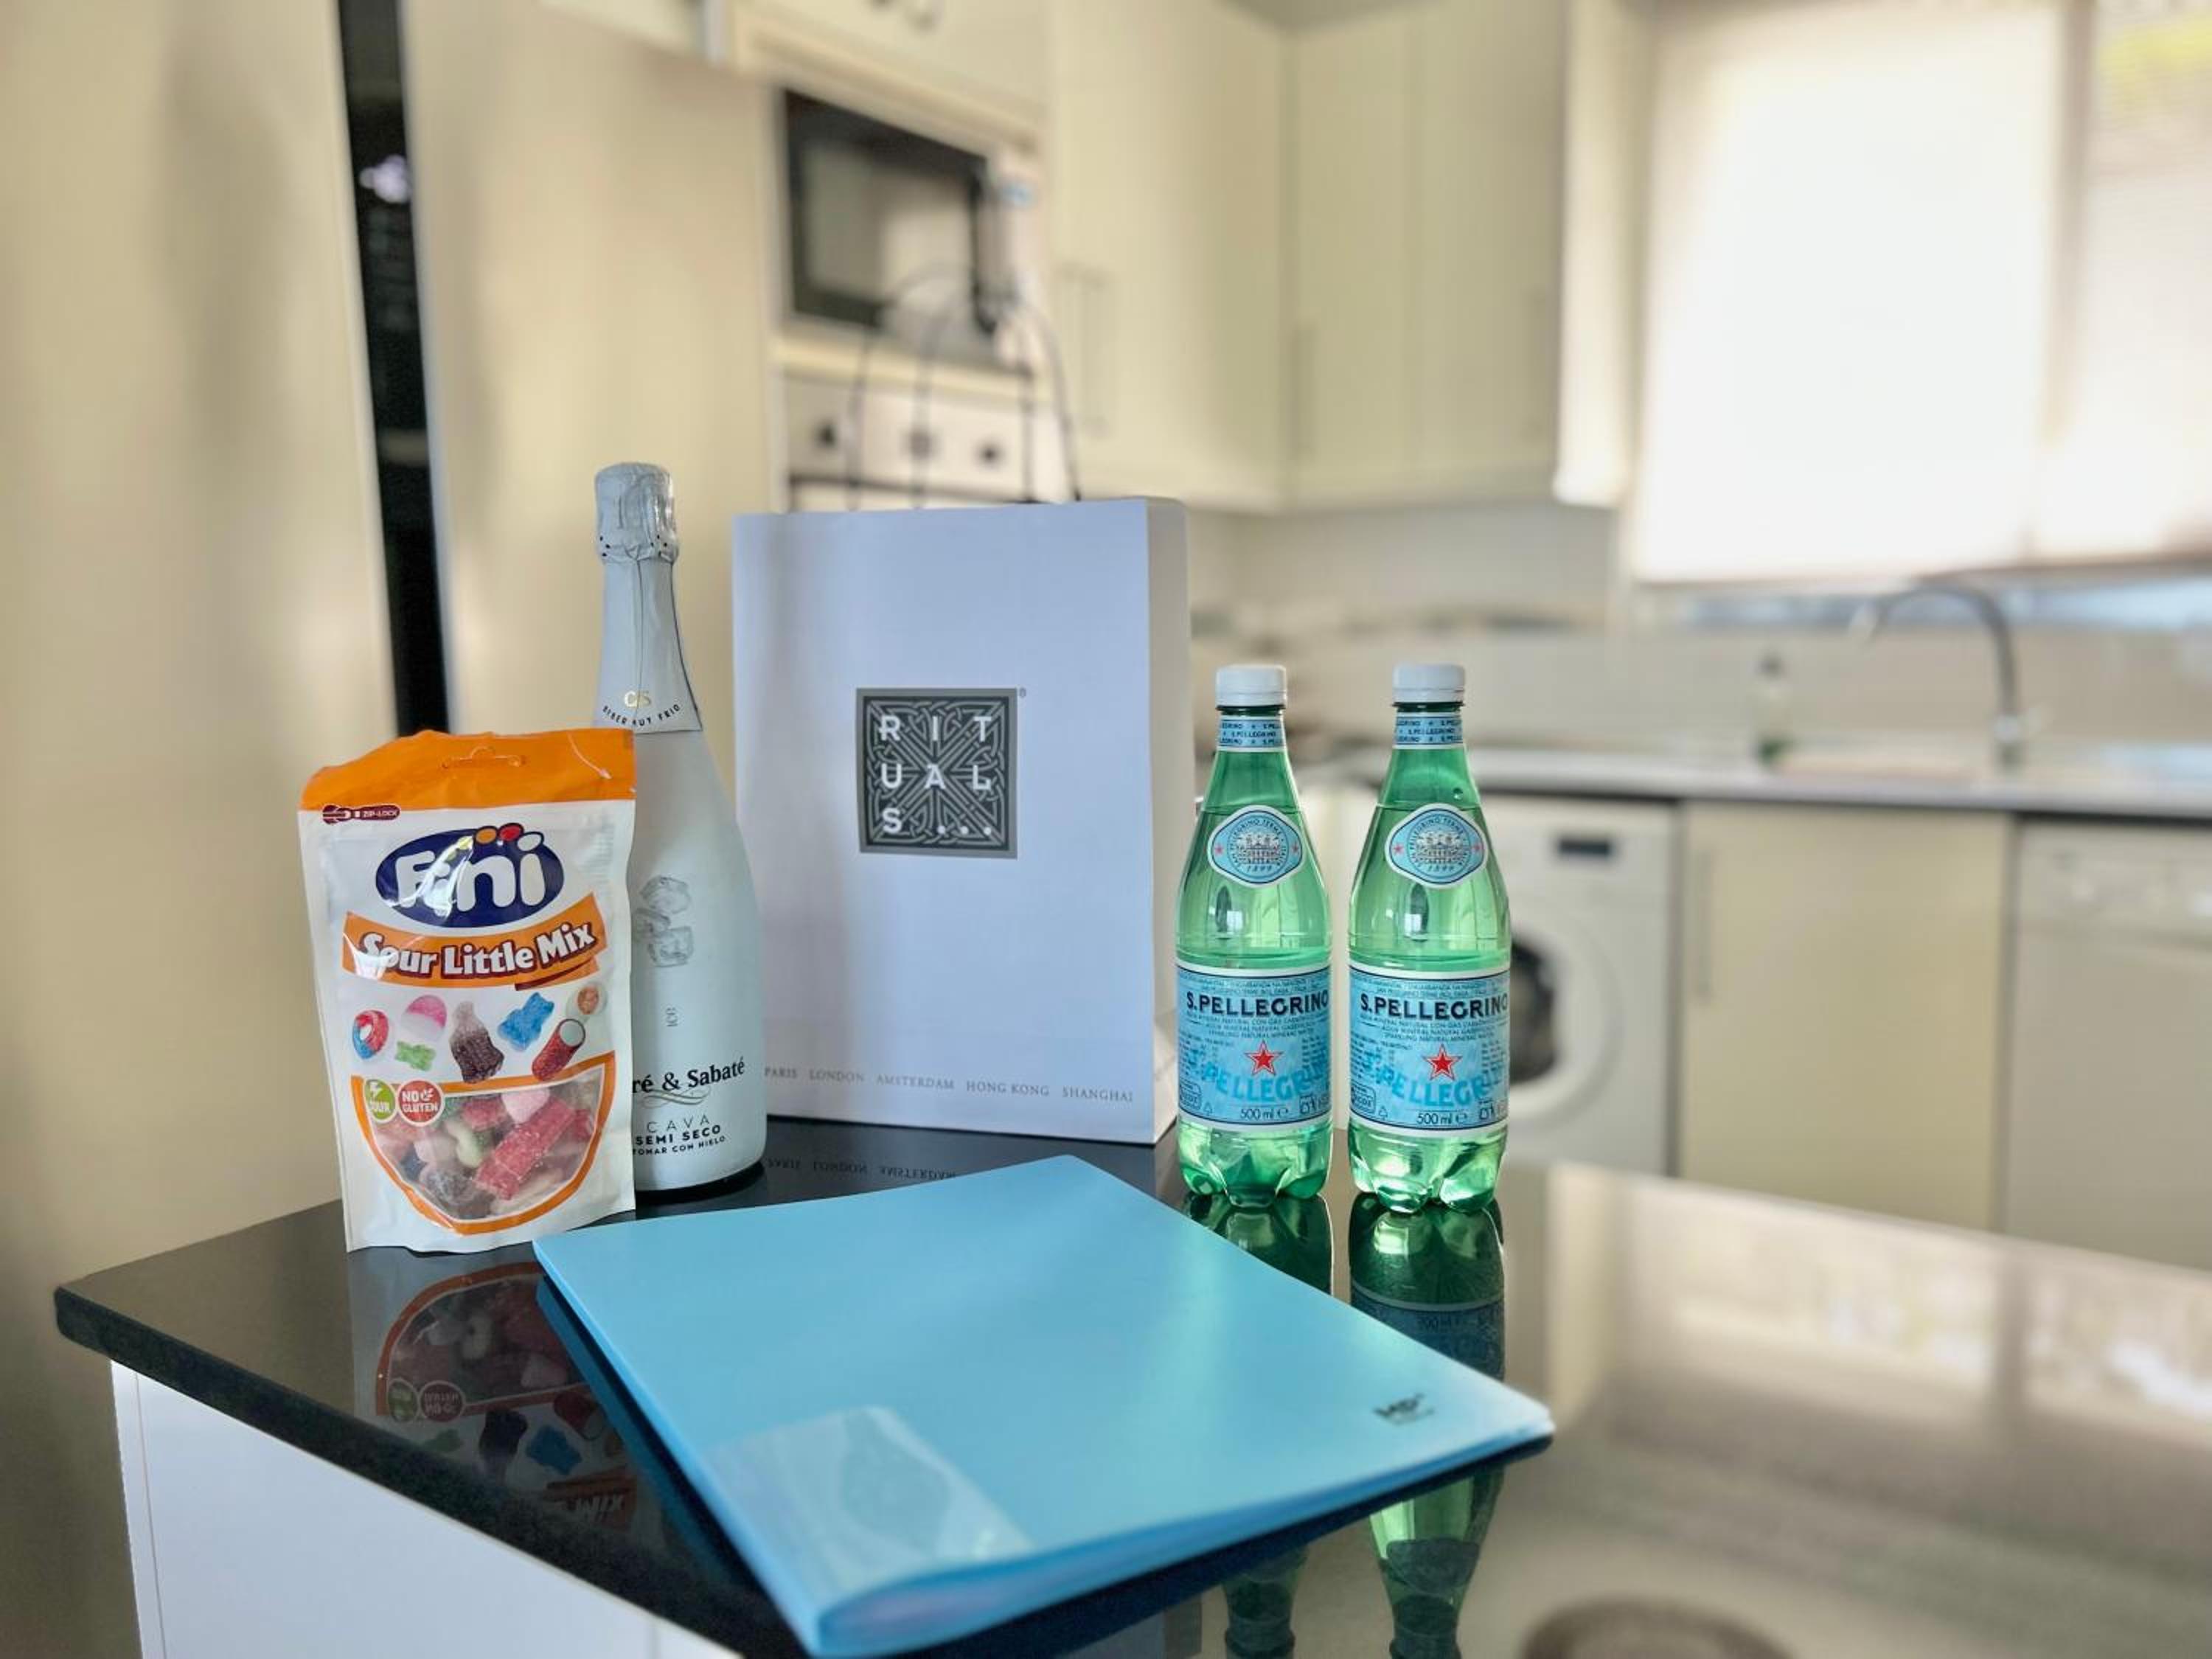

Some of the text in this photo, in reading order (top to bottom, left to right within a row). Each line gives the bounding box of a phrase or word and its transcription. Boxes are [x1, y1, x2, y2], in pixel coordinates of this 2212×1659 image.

[361, 922, 597, 979] Sour Little Mix
[1186, 989, 1329, 1017] S.PELLEGRINO
[1360, 992, 1508, 1020] S.PELLEGRINO
[661, 1071, 681, 1091] &
[687, 1056, 745, 1088] Sabaté
[809, 1068, 864, 1082] LONDON
[877, 1073, 955, 1090] AMSTERDAM
[967, 1080, 1006, 1094] HONG
[1011, 1082, 1050, 1096] KONG
[1062, 1086, 1133, 1103] SHANGHAI
[402, 1091, 419, 1102] NO
[402, 1102, 438, 1113] GLUTEN
[1239, 1107, 1261, 1120] 500
[1262, 1107, 1274, 1119] ml
[647, 1114, 710, 1133] CAVA
[1416, 1113, 1438, 1124] 500
[1440, 1113, 1452, 1124] ml
[636, 1124, 721, 1146] SEMI SECO
[672, 1143, 694, 1152] CON
[698, 1135, 726, 1148] HIELO
